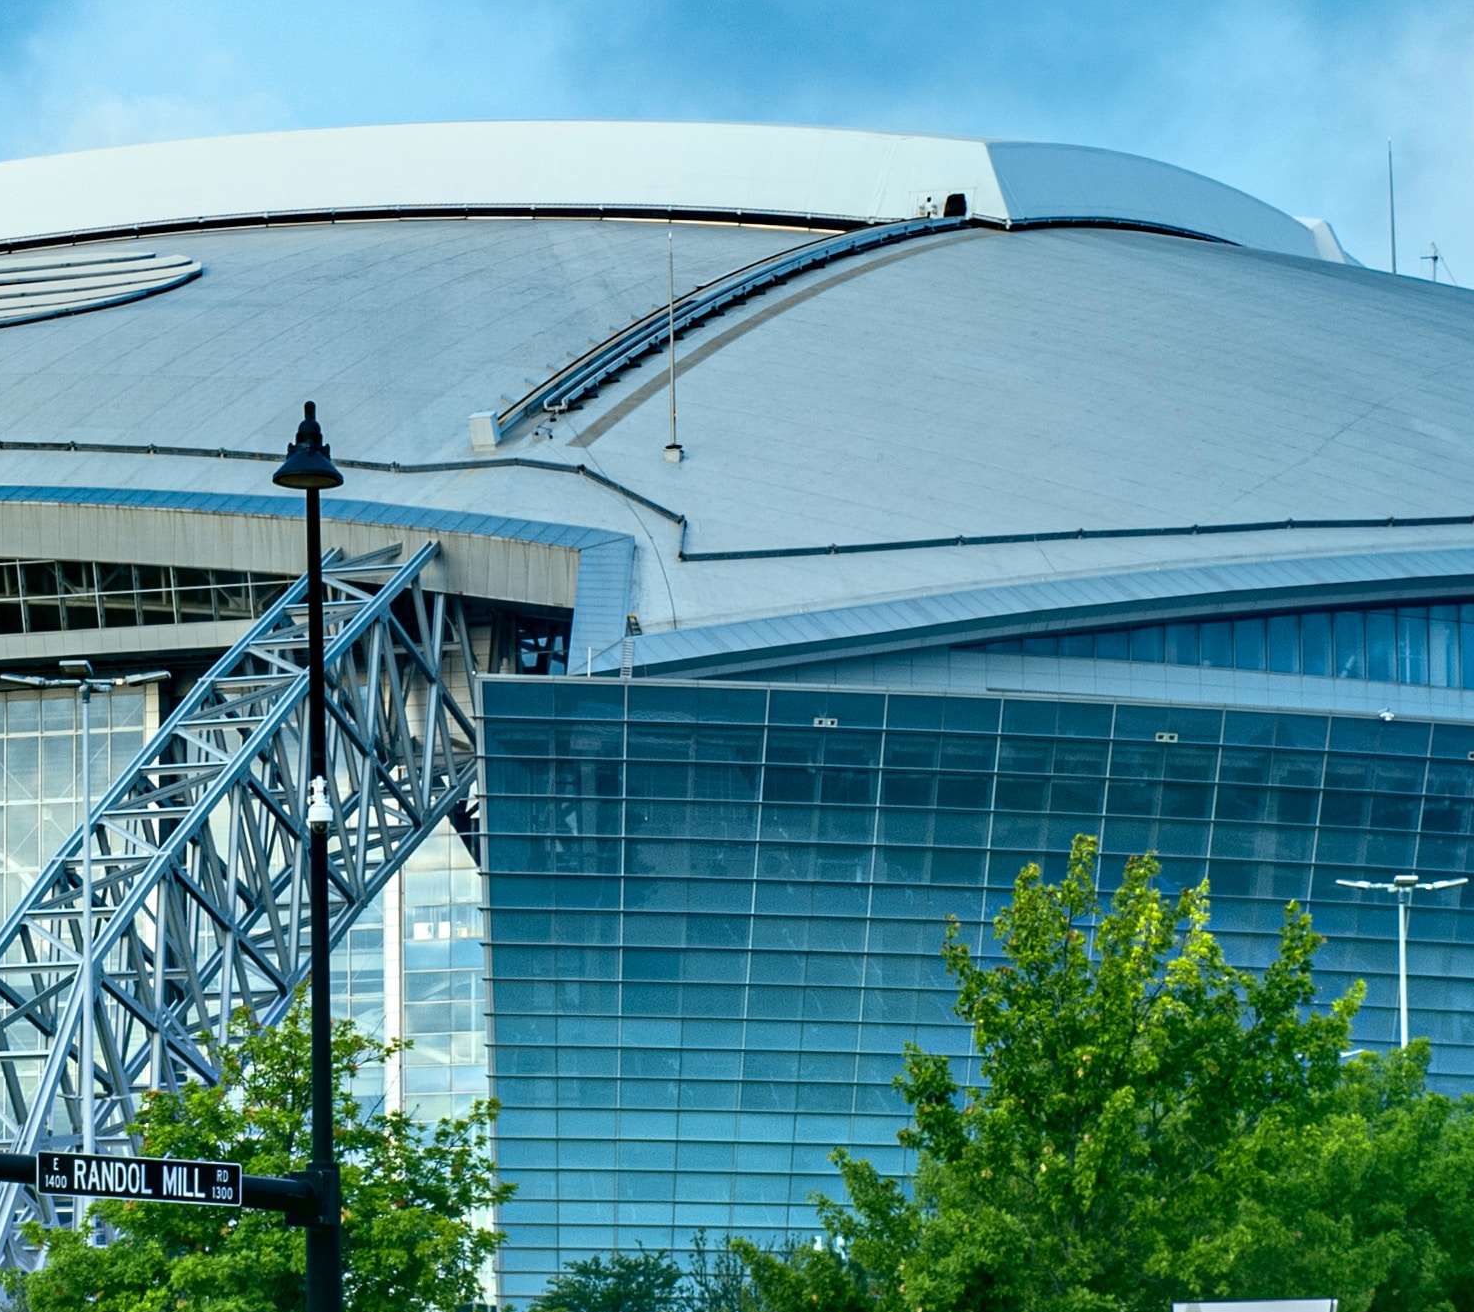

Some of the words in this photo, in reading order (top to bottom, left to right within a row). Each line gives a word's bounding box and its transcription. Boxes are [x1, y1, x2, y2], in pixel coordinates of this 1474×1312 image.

[53, 1158, 58, 1171] E
[45, 1175, 67, 1188] 1400
[74, 1159, 152, 1194] RANDOL
[163, 1165, 205, 1198] MILL
[216, 1170, 228, 1183] RD
[212, 1187, 233, 1200] 1300
